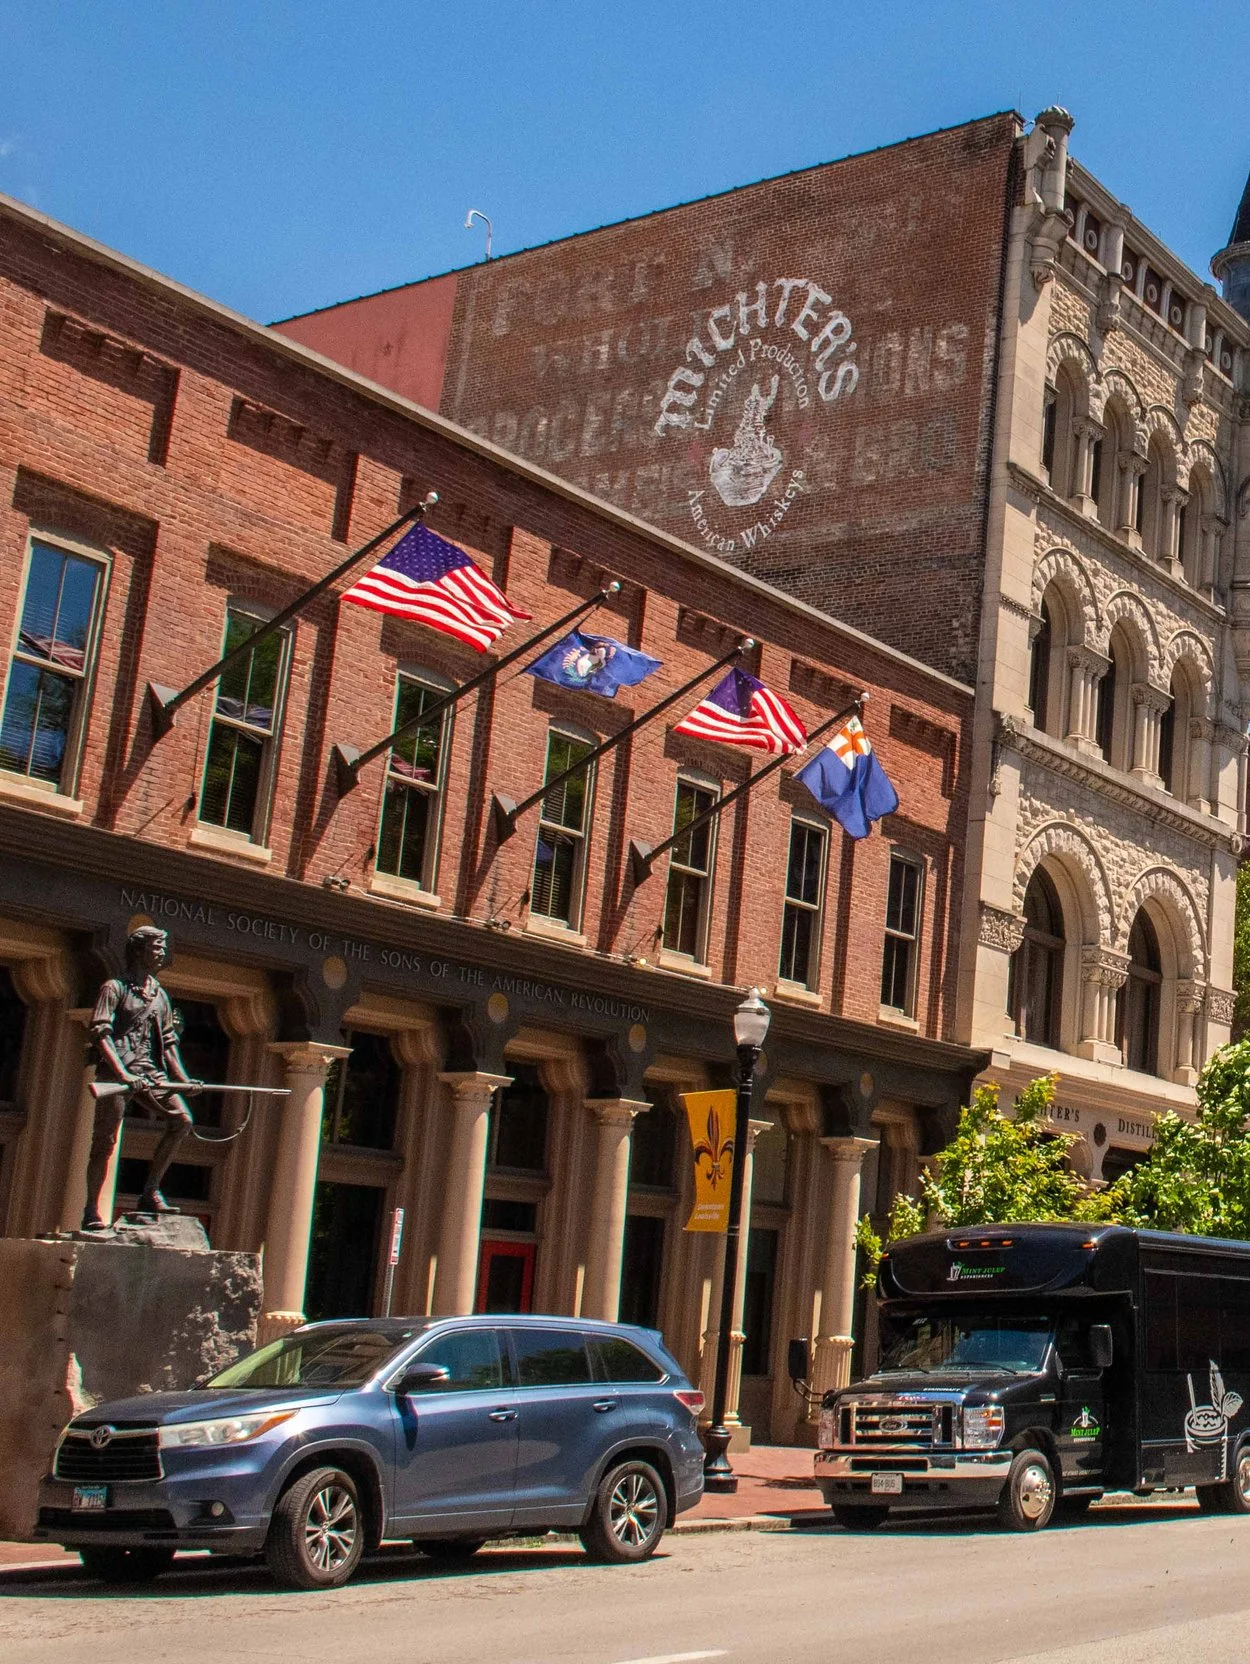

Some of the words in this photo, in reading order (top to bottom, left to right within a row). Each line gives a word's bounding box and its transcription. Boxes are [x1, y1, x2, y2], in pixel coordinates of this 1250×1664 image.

[654, 278, 859, 437] MICHTER'S
[694, 349, 746, 430] Limited
[749, 338, 811, 410] Production
[688, 490, 735, 551] American
[740, 469, 804, 548] Whiskeys
[120, 888, 216, 926] NATIONAL
[226, 913, 299, 944] SOCIETY
[308, 932, 331, 951] OF
[342, 939, 370, 962] THE
[379, 950, 422, 973] SONS
[430, 961, 450, 978] OF
[458, 966, 485, 987] THE
[491, 975, 564, 1005] AMERICAN
[571, 993, 651, 1023] REVOLUTION
[1118, 1118, 1156, 1139] DISTILL
